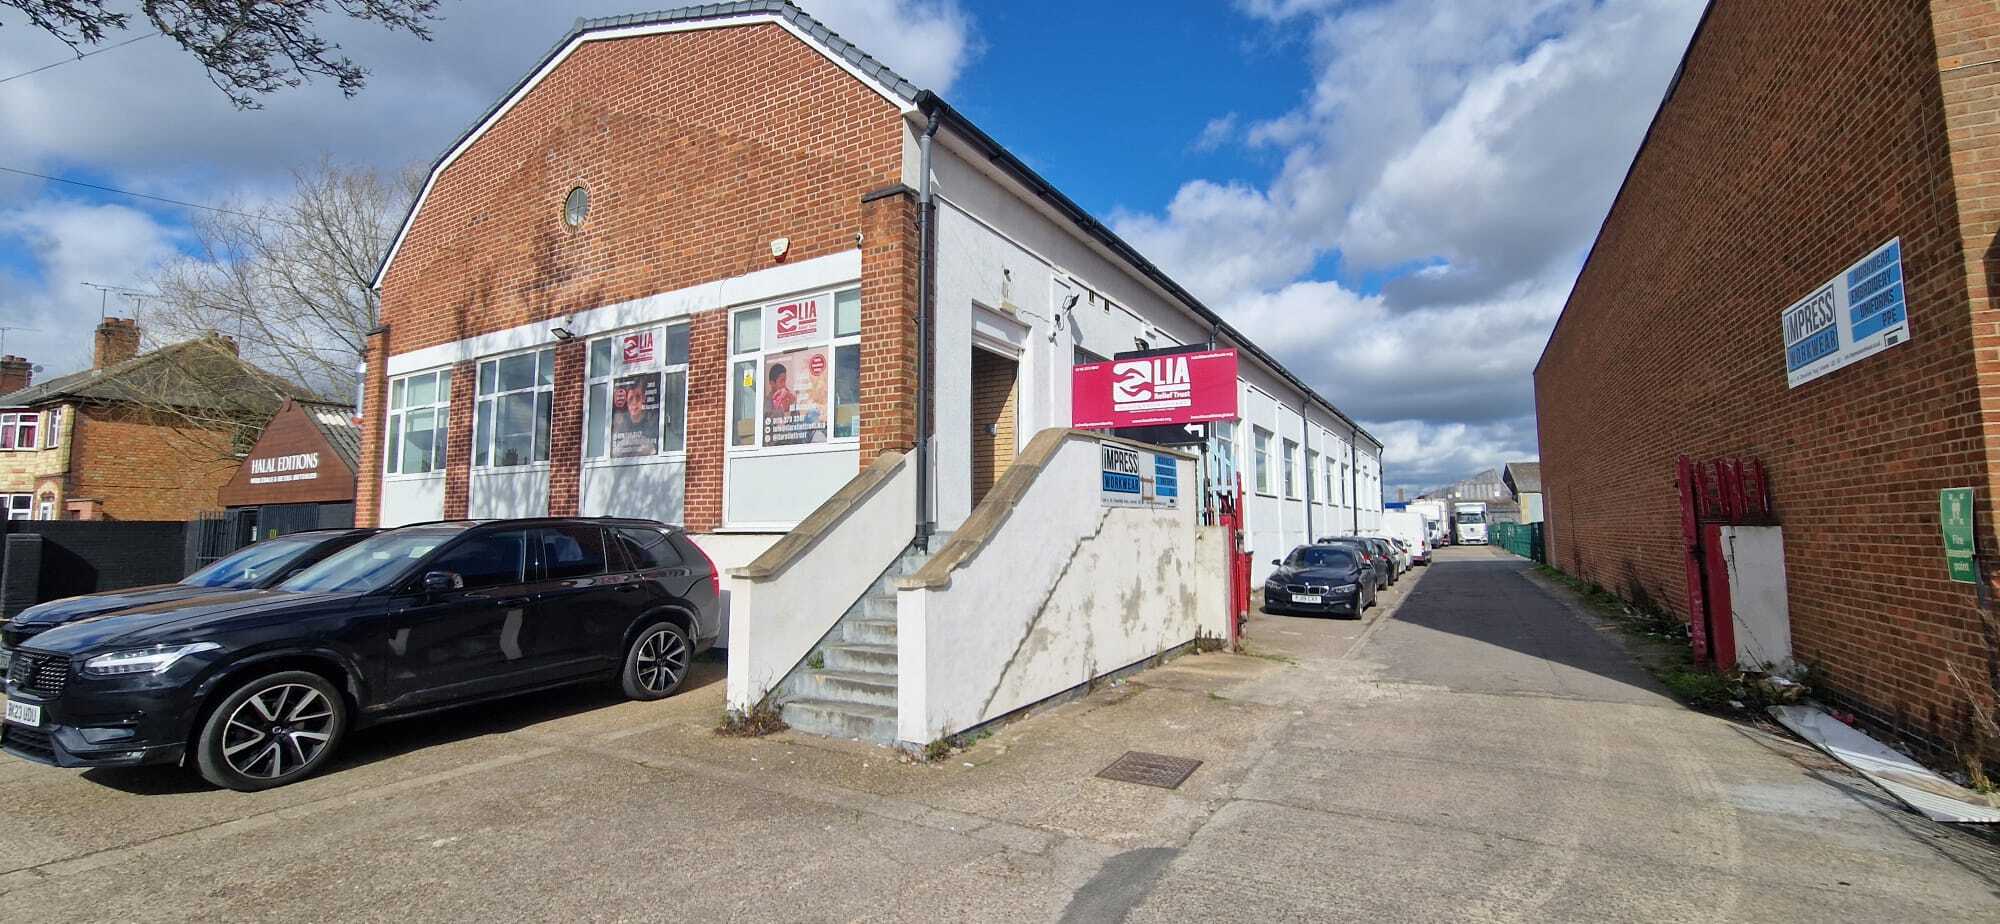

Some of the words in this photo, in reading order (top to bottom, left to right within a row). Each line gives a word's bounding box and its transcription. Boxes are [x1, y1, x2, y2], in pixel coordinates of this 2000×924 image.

[798, 300, 817, 320] LIA
[1882, 308, 1897, 327] PPE
[639, 331, 653, 350] LIA
[1789, 329, 1837, 367] WORKWEAR
[1153, 356, 1191, 385] LIA
[1154, 392, 1173, 401] Relief
[1173, 390, 1191, 399] Trust
[251, 457, 277, 474] HALAL
[277, 452, 319, 472] EDITIONS
[1104, 475, 1139, 491] WORKWEAR
